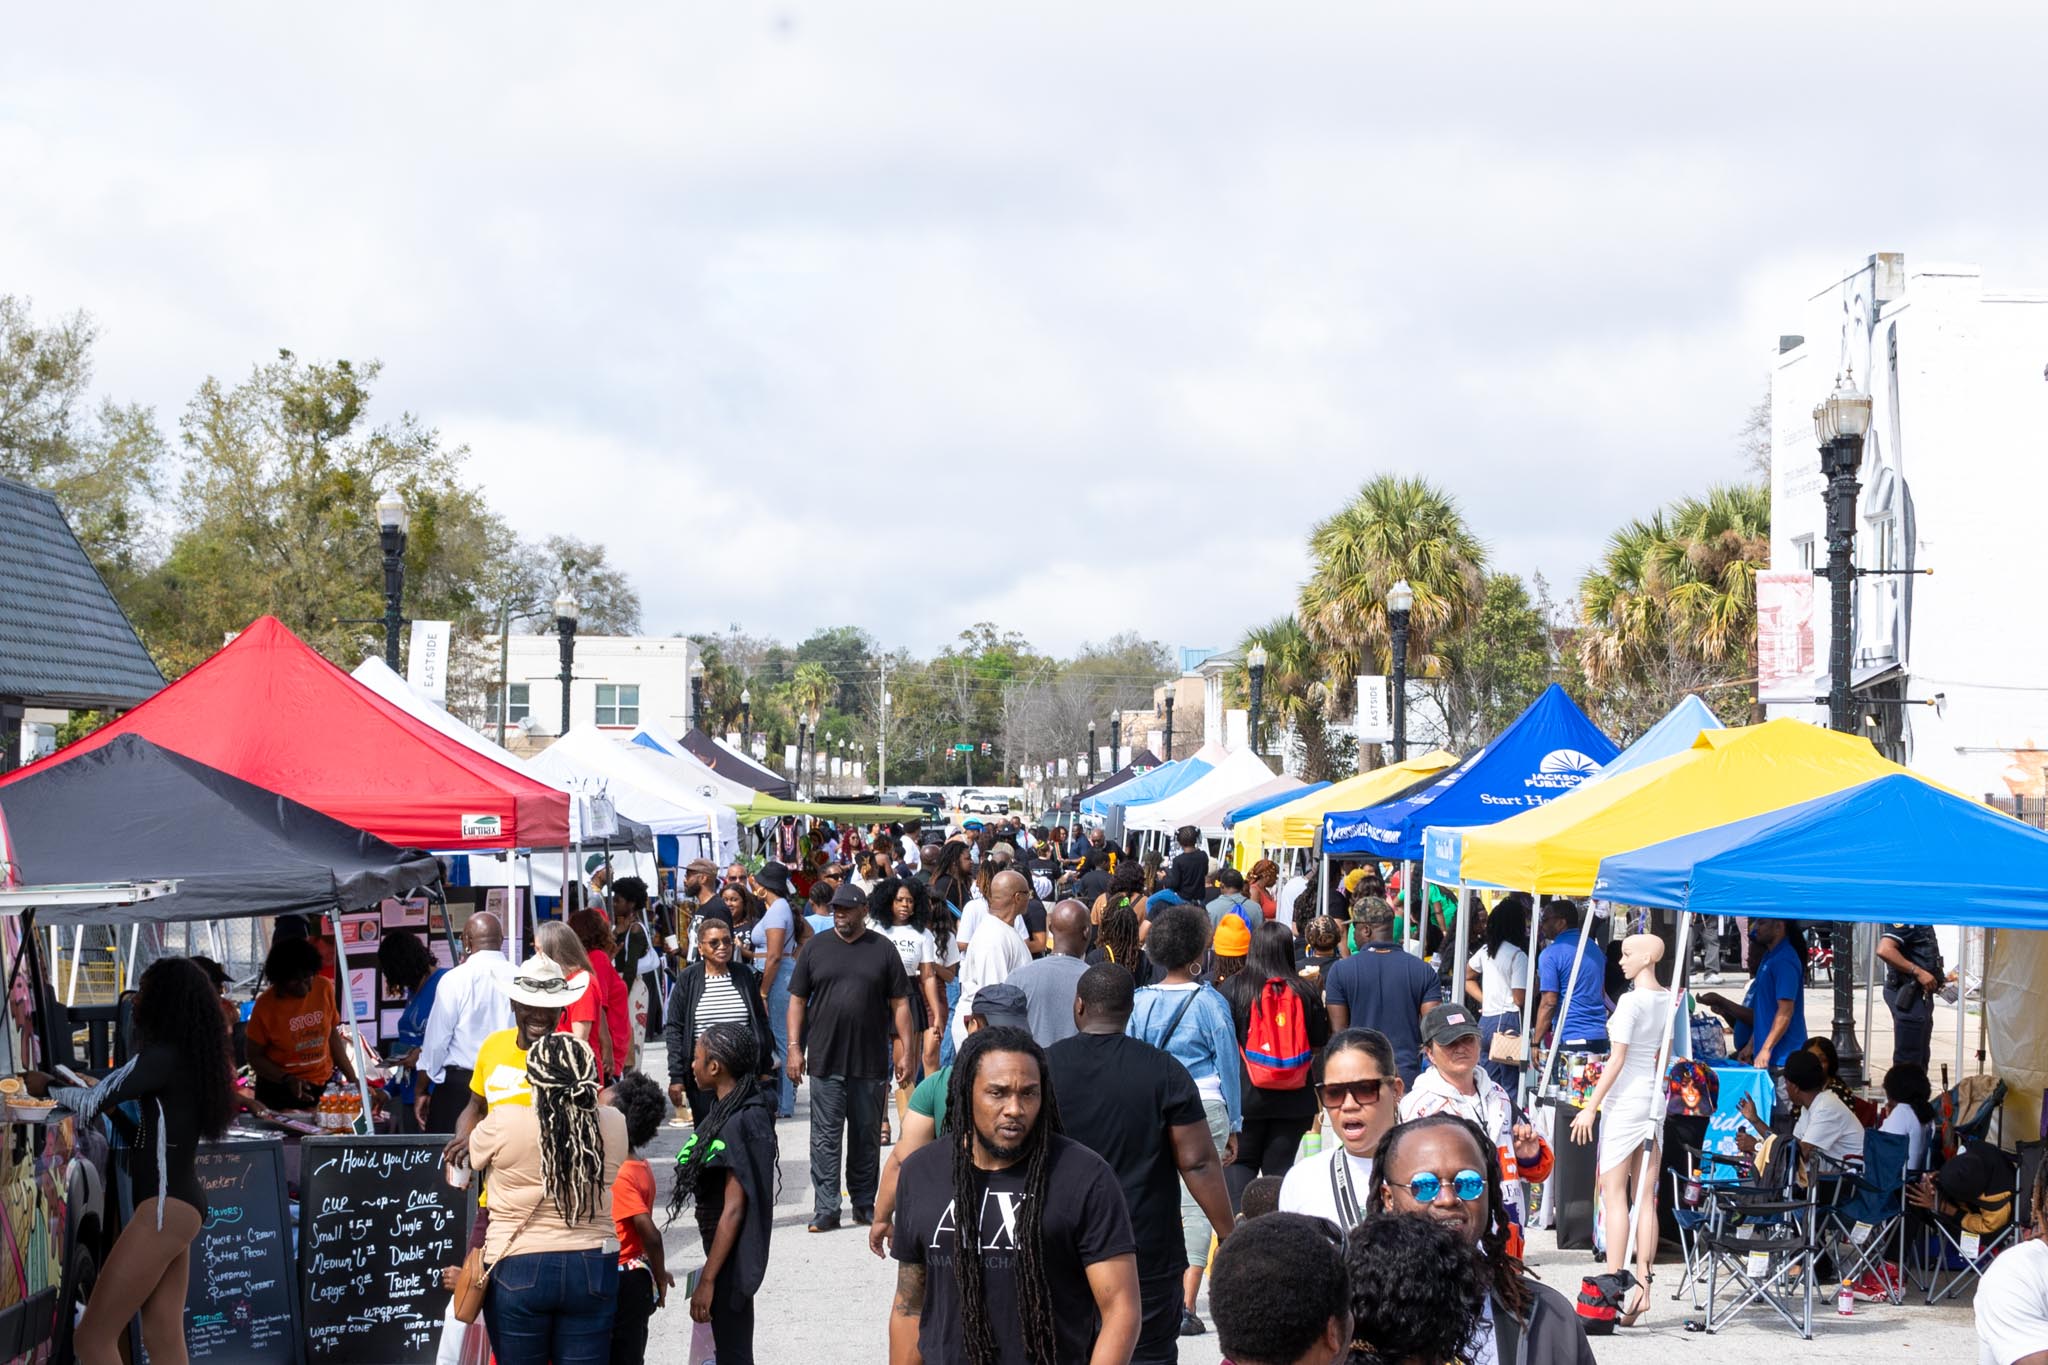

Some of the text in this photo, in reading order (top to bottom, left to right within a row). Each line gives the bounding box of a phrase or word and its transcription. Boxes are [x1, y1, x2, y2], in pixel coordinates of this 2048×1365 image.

[423, 633, 438, 687] EASTSIDE
[1370, 685, 1378, 727] EASTSIDE
[1524, 779, 1576, 789] PUBLIC
[1480, 793, 1523, 806] Start
[463, 825, 496, 835] Eurmax
[289, 1010, 323, 1032] STOP
[322, 1196, 349, 1213] CUP
[407, 1189, 438, 1208] CONE
[309, 1222, 342, 1249] Small
[363, 1304, 411, 1318] UPGRADE
[310, 1323, 372, 1338] WAFFLE CONE
